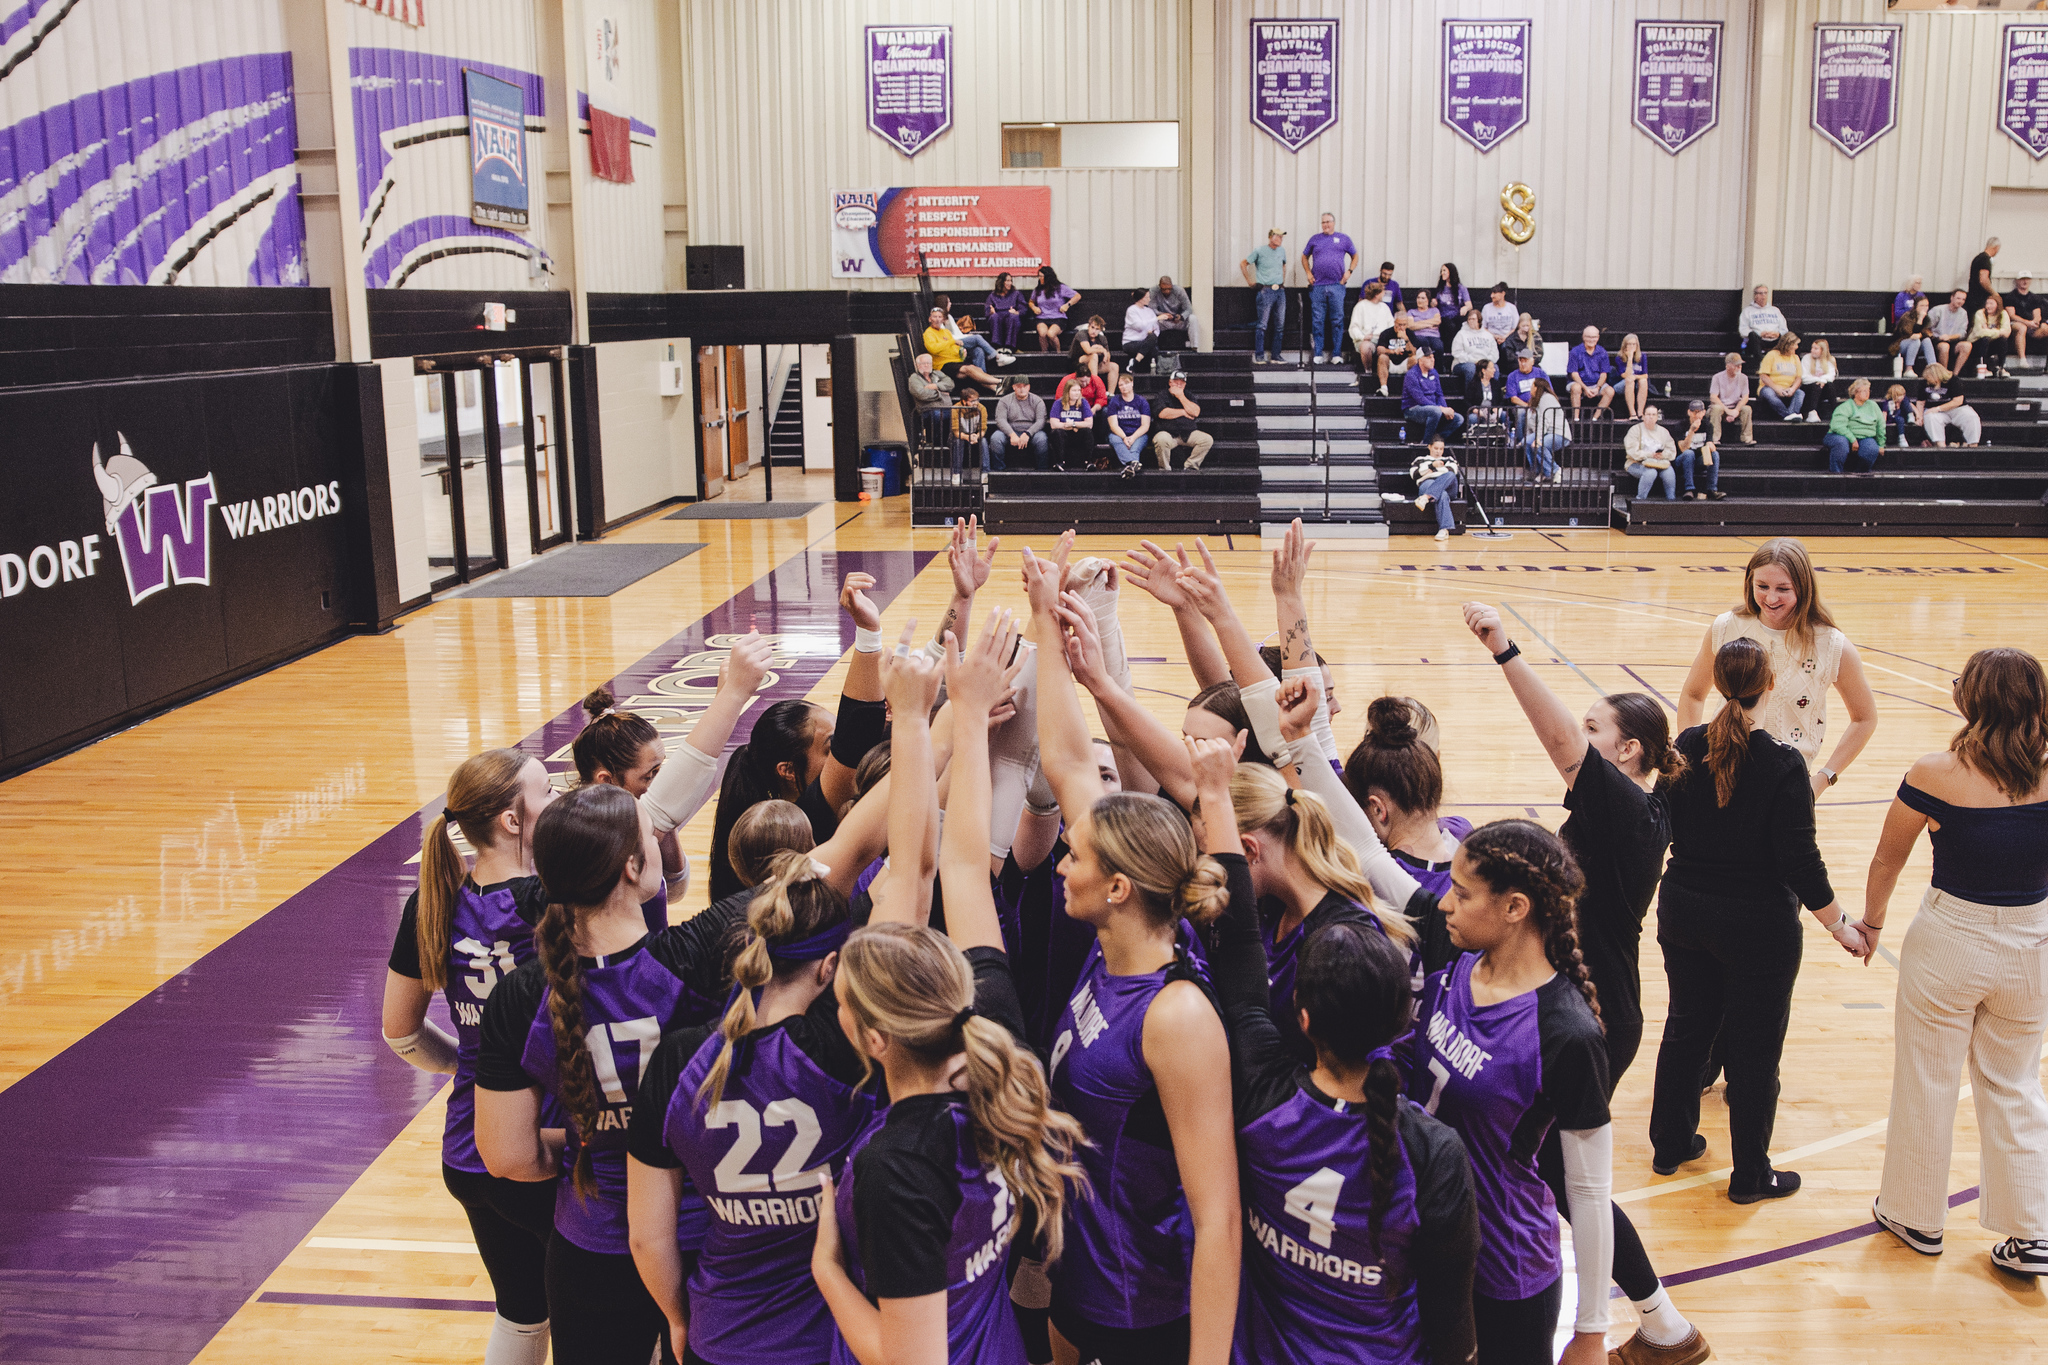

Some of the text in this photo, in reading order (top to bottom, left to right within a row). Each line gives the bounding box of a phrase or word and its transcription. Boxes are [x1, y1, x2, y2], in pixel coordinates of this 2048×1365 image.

[875, 32, 943, 45] WALDORF
[1261, 26, 1328, 39] WALDORF
[1453, 26, 1521, 39] WALDORF
[1645, 27, 1712, 41] WALDORF
[1825, 30, 1891, 43] WALDORF
[2015, 31, 2048, 45] WAL
[886, 46, 932, 59] National
[1267, 40, 1323, 52] FOOTBALL
[1452, 40, 1522, 55] MEN'S SOCCER
[1646, 41, 1710, 55] VOLLEYBALL
[1847, 44, 1890, 58] BASKETBALL
[873, 59, 945, 75] CHAMPIONS
[1258, 60, 1331, 75] CHAMPIONS
[1450, 60, 1523, 74] CHAMPIONS
[1641, 61, 1713, 77] CHAMPIONS
[1820, 64, 1892, 79] CHAMPIONS
[2009, 65, 2048, 80] CHAM
[474, 119, 520, 173] NAIA
[836, 194, 875, 208] NAIA
[918, 196, 980, 207] INTEGRITY
[919, 211, 968, 222] RESPECT
[1500, 181, 1536, 245] 8
[919, 226, 1011, 237] RESPONSIBILITY
[919, 242, 1013, 253] SPORTSMANSHIP
[841, 259, 864, 272] W
[920, 257, 1042, 268] ERVANT LEADERSHIP
[0, 471, 341, 607] DORF W WARRIORS
[1680, 565, 2014, 574] JEROE
[453, 936, 518, 1000] 31
[1069, 979, 1110, 1049] WALDORF
[1426, 1010, 1493, 1080] WALDORF
[584, 1016, 661, 1103] 17
[1424, 1055, 1451, 1116] 7
[704, 1097, 833, 1193] 22
[706, 1195, 823, 1226] WARRIO
[1284, 1166, 1345, 1250] 4
[1249, 1206, 1383, 1286] WARRIORS
